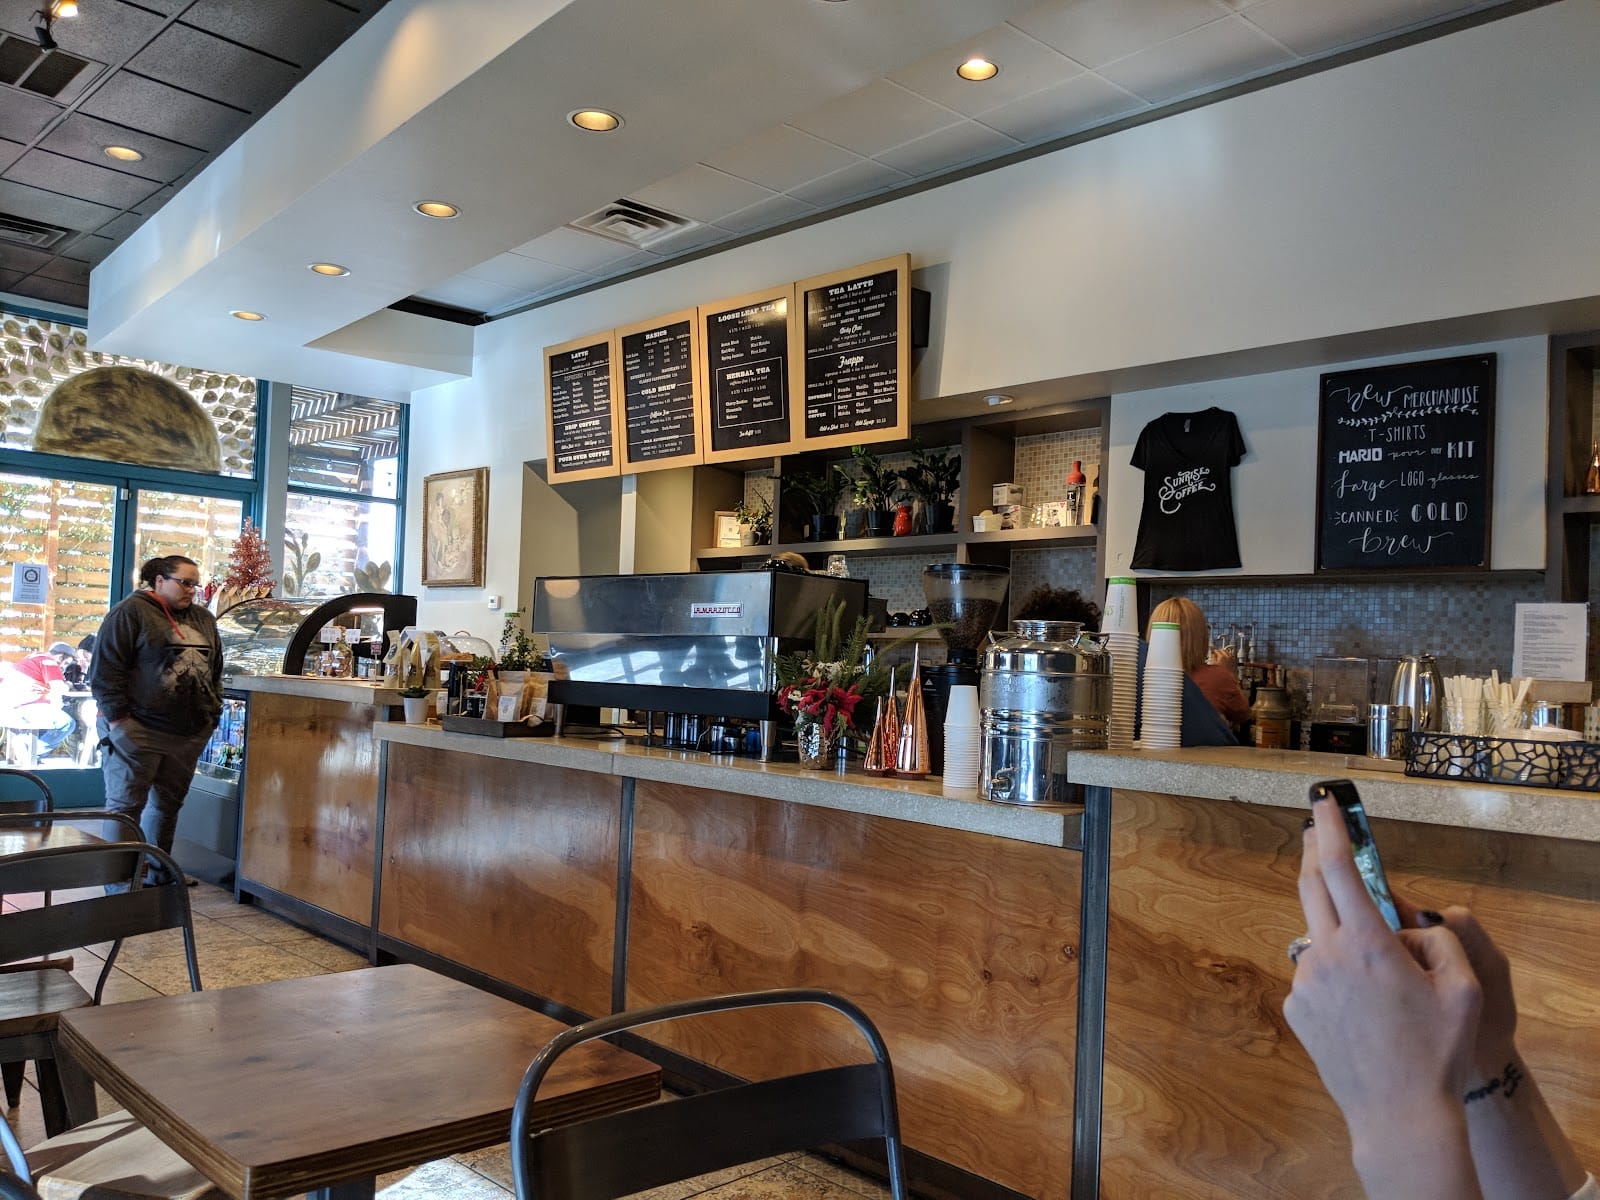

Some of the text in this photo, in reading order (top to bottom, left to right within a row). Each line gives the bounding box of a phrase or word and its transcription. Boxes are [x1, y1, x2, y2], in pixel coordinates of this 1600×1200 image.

[829, 280, 874, 296] TEA LATTE
[718, 304, 776, 323] LOOSE LEAF TEA
[645, 329, 667, 340] BASICS
[571, 350, 589, 359] LATTE
[838, 355, 864, 369] Frappe
[726, 366, 771, 380] HERBAL TEA
[641, 383, 676, 395] COLD BREW
[1403, 385, 1480, 409] MERCHANDISE
[579, 419, 600, 428] COFFEE
[1368, 424, 1426, 442] T-SHIRTS
[572, 453, 587, 461] OVER
[588, 450, 610, 458] COFFEE
[1338, 447, 1383, 464] HARIO
[1447, 440, 1475, 459] KIT
[1400, 470, 1424, 487] LOGO
[1340, 501, 1468, 523] CANNED COLD
